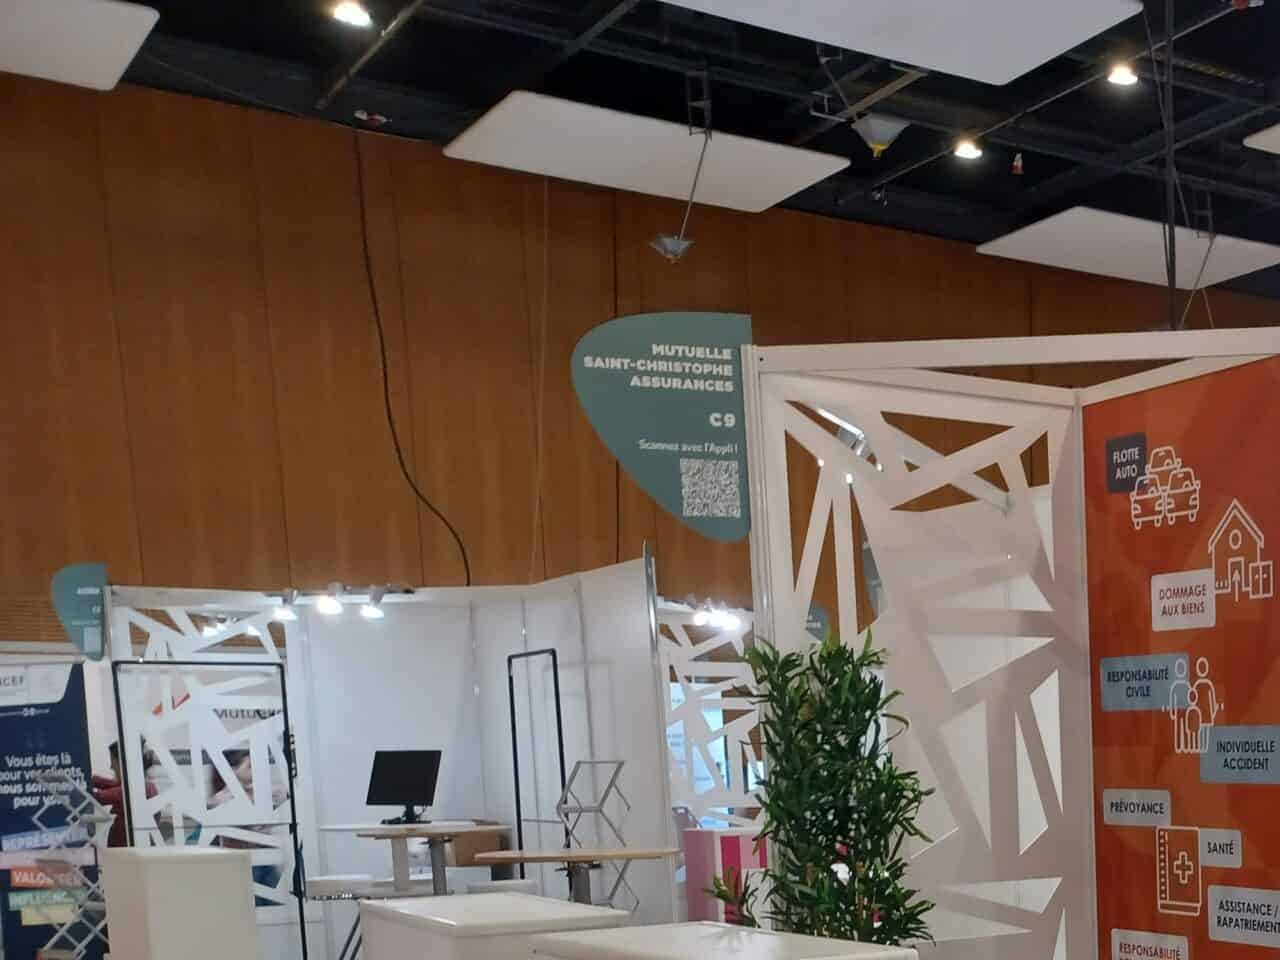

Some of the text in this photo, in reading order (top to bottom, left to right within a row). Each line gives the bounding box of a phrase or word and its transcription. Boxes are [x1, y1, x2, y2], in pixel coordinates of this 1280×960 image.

[652, 343, 733, 360] MUTUELLE
[583, 356, 734, 377] SAINT-CHRISTOPHE
[630, 375, 735, 392] ASSURANCES
[709, 412, 736, 428] C9
[1113, 447, 1140, 464] FLOTTE
[1116, 465, 1138, 480] AUTO
[1159, 583, 1207, 601] DOMMAGE
[1161, 601, 1206, 617] AUX BIENS
[1107, 667, 1169, 683] RESPONSABILITÉ
[1125, 685, 1151, 698] CIVILE
[1216, 740, 1276, 753] INDIVIDUELLE
[5, 754, 33, 767] Vous
[61, 752, 71, 765] là
[1223, 757, 1269, 771] ACCIDENT
[1110, 798, 1165, 815] PRÉVOYANCE
[1207, 840, 1234, 855] SANTÉ
[1218, 899, 1272, 916] ASSISTANCE
[1216, 915, 1280, 934] RAPATRIEMENT
[1119, 942, 1181, 960] RESPONSABILITÉ
